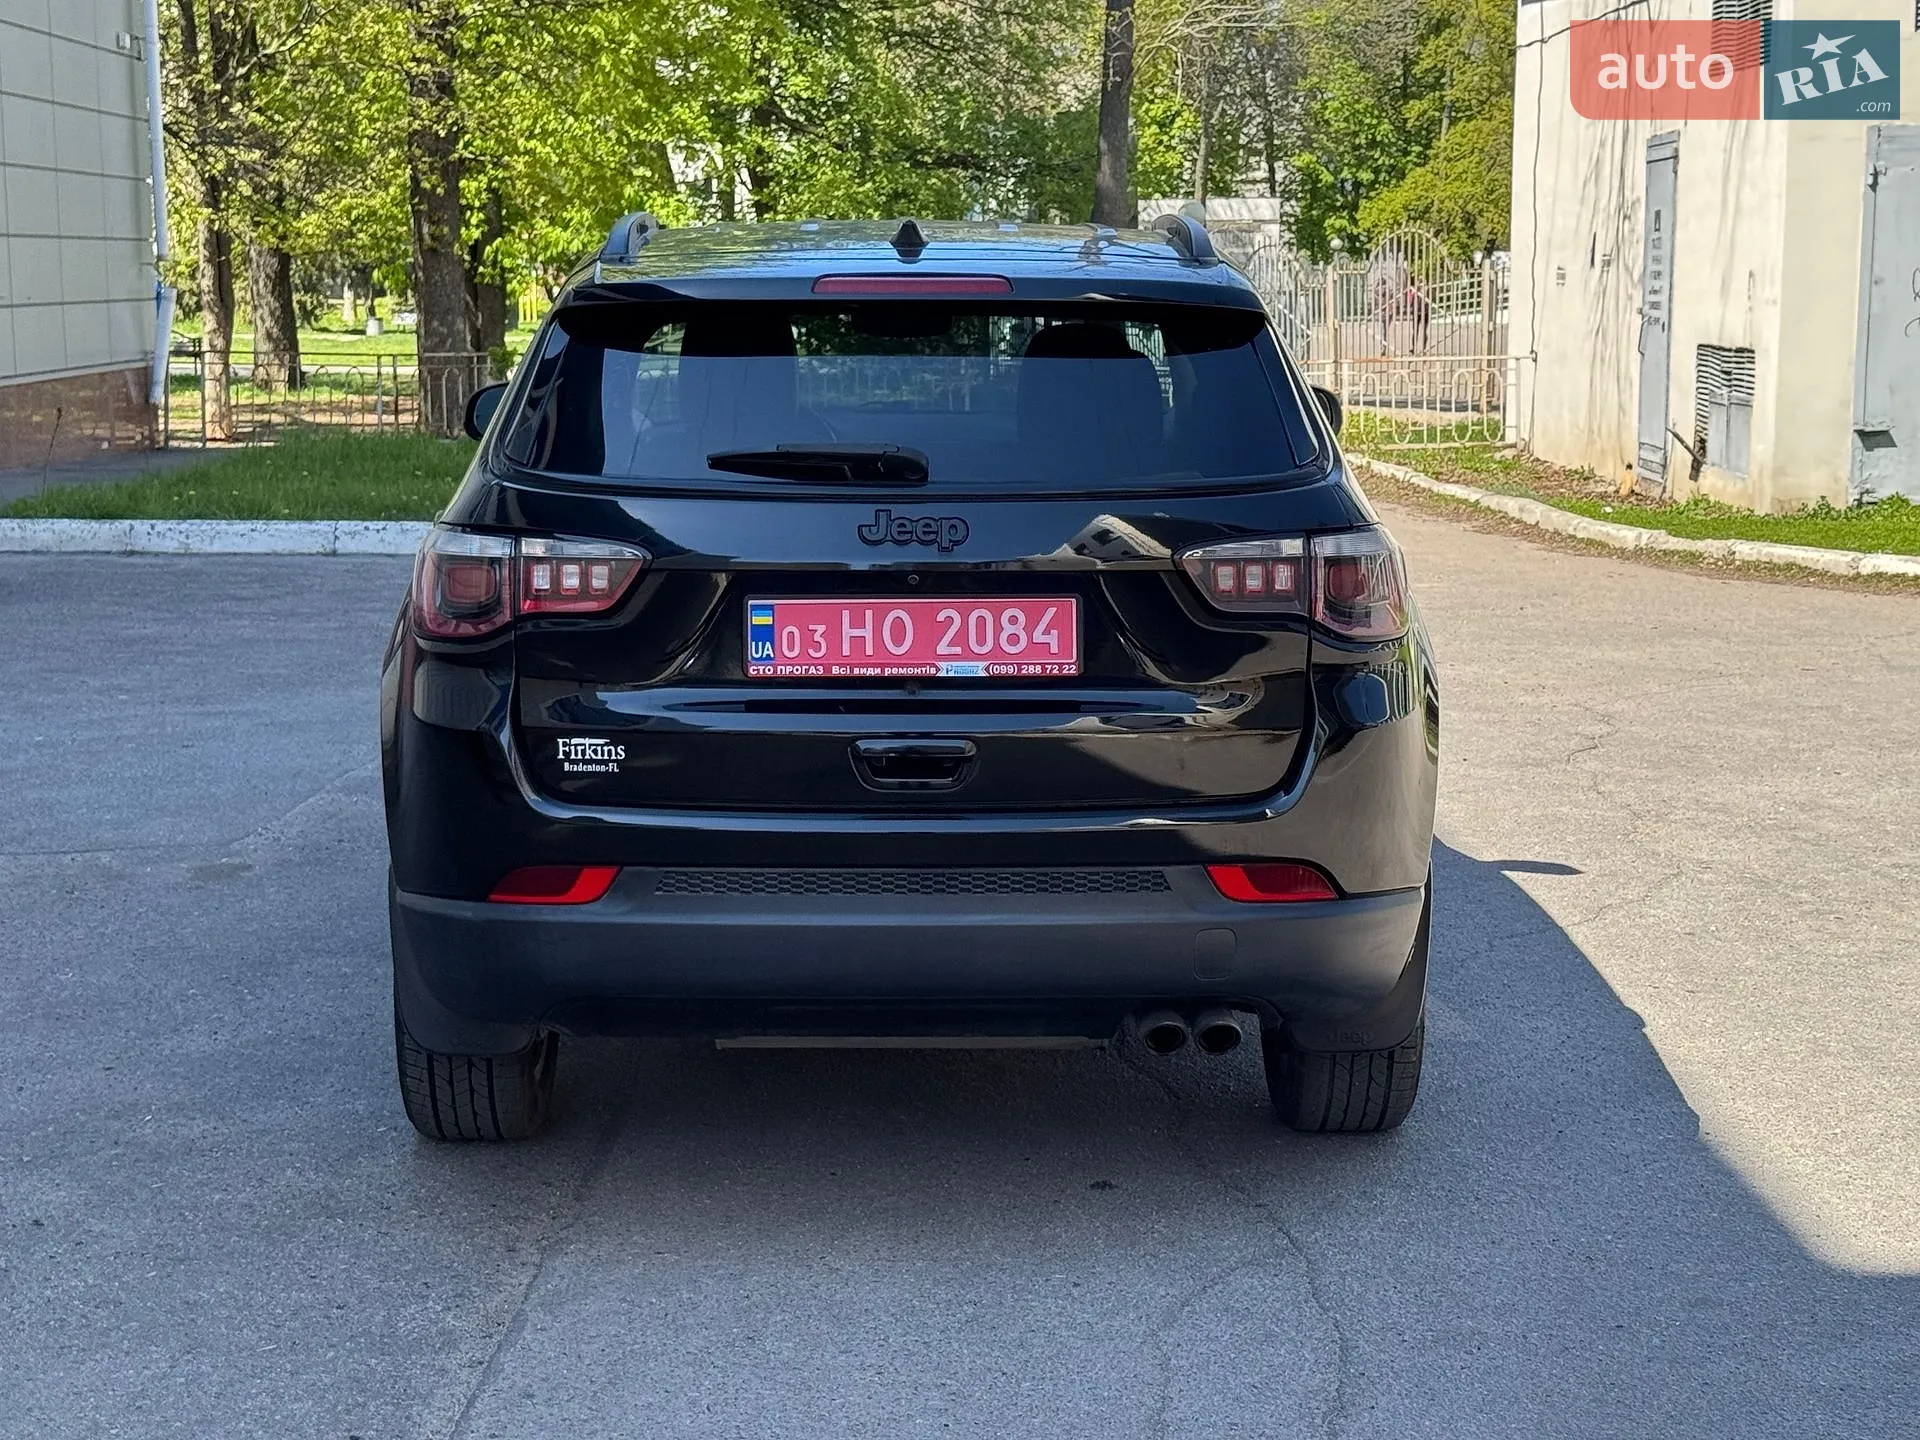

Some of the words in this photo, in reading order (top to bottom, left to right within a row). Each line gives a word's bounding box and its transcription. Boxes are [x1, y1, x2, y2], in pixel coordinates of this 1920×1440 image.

[857, 508, 969, 552] Jeep
[751, 641, 774, 659] UA
[781, 624, 827, 659] 03
[935, 607, 1059, 656] 2084
[749, 665, 774, 675] СТО
[777, 665, 824, 675] ПРОГАЗ
[831, 665, 850, 675] Всі
[854, 667, 881, 677] види
[884, 665, 937, 677] ремонтів
[989, 663, 1018, 676] (099)
[1021, 664, 1042, 675] 288
[1045, 664, 1061, 675] 72
[1062, 664, 1077, 675] 22
[556, 737, 626, 760] Firkins
